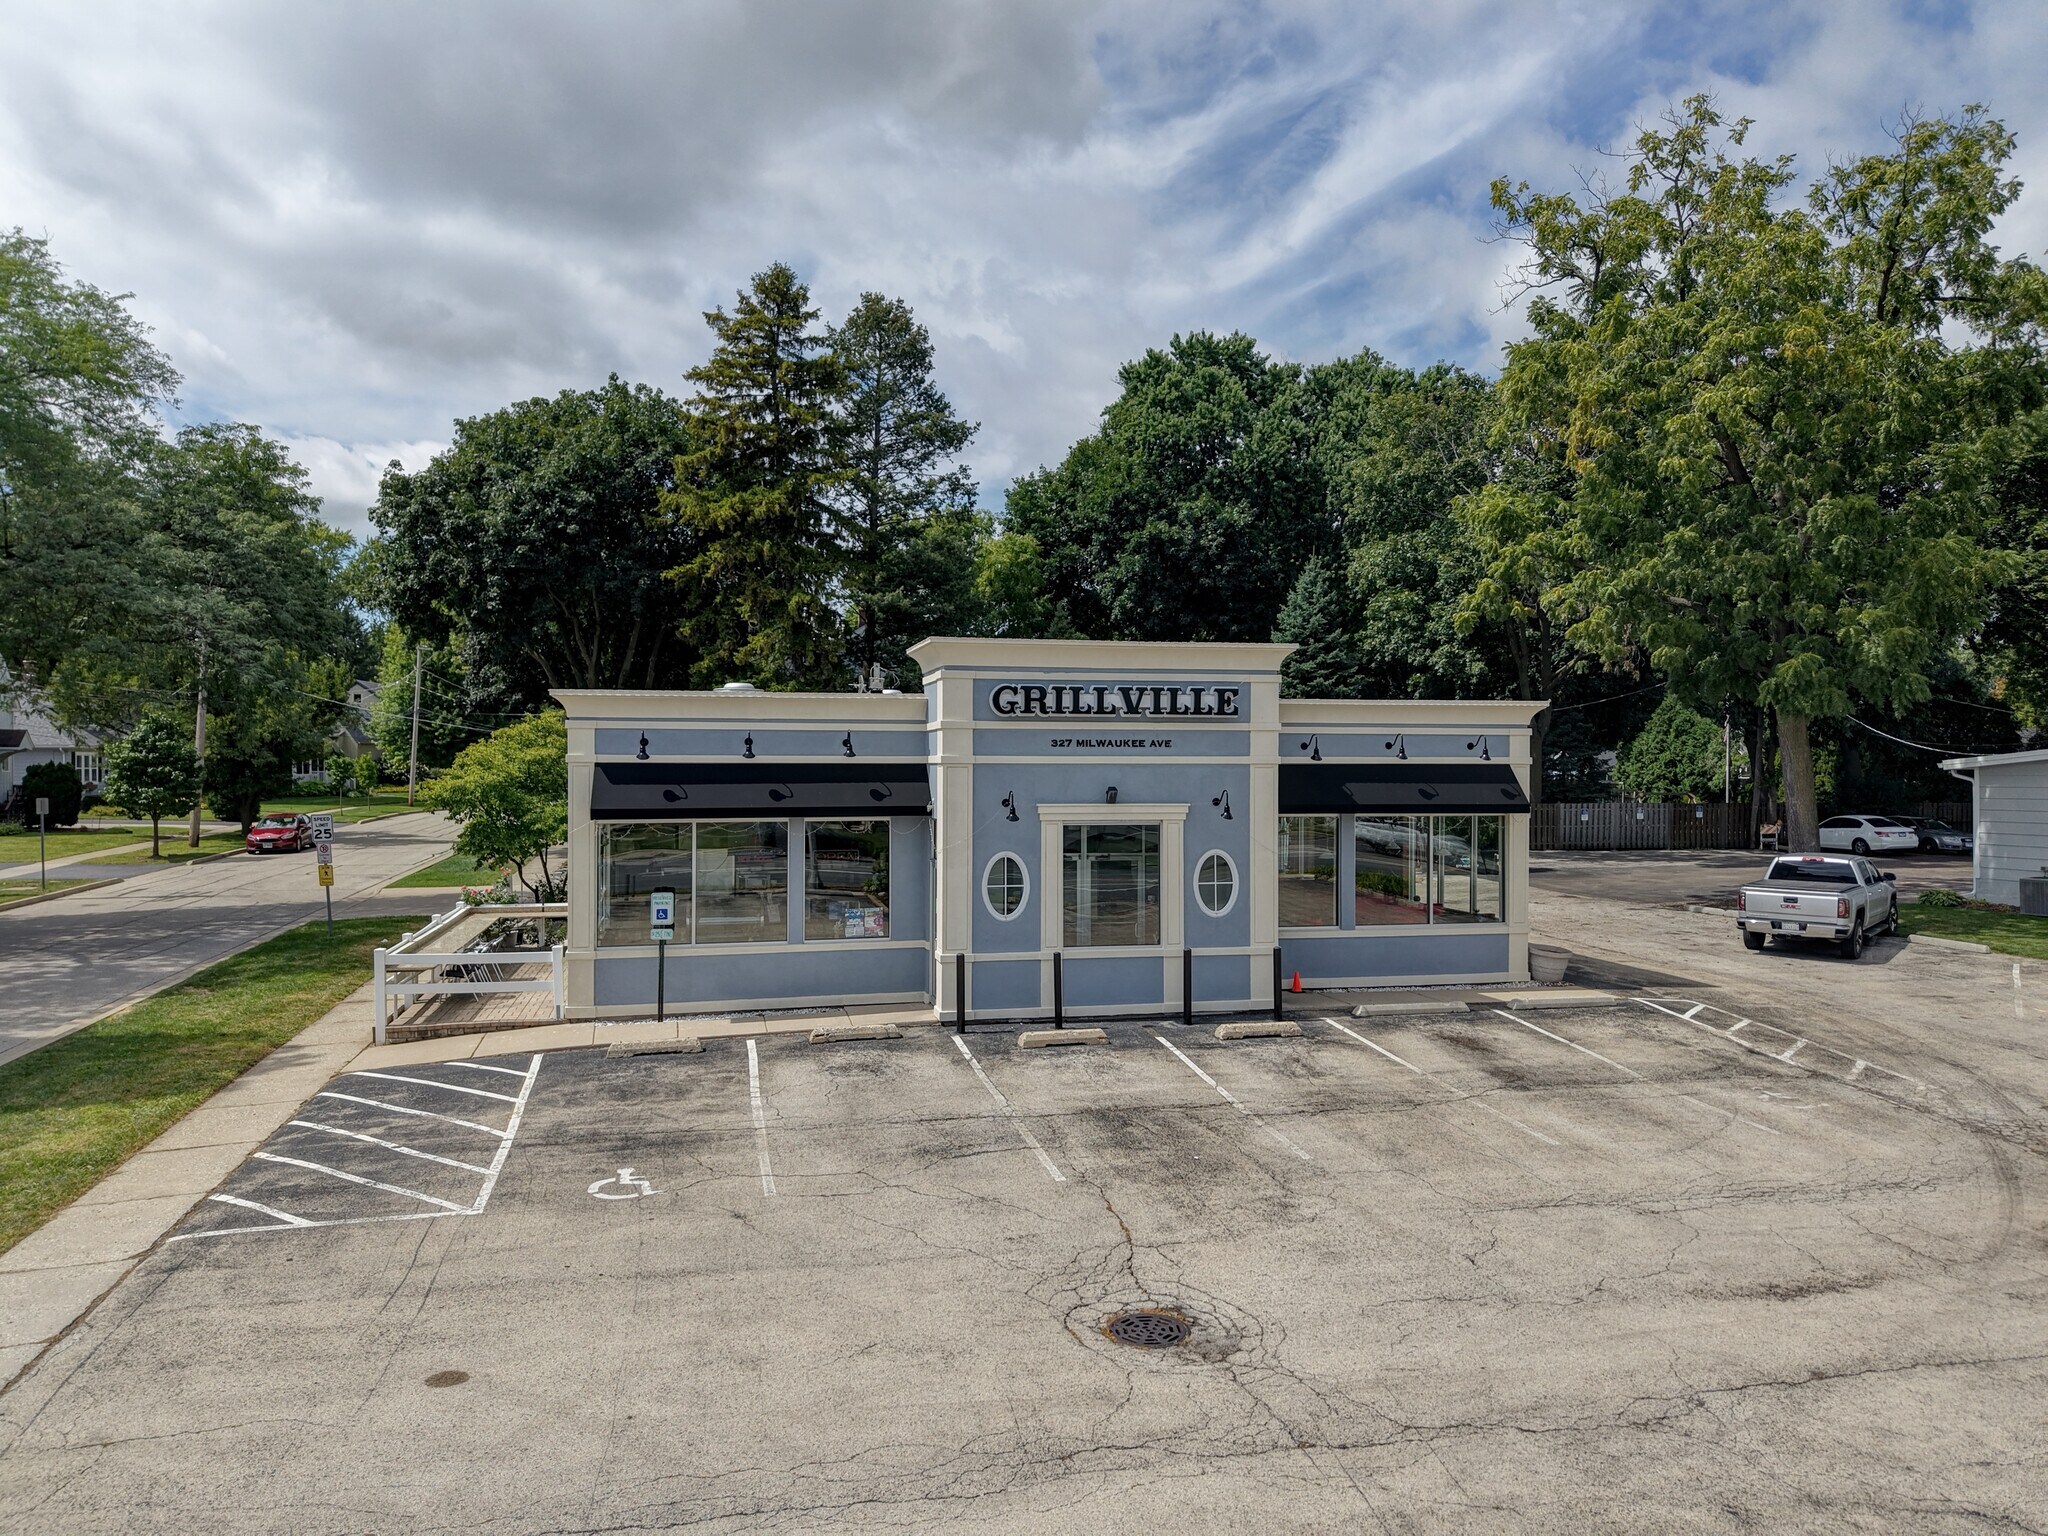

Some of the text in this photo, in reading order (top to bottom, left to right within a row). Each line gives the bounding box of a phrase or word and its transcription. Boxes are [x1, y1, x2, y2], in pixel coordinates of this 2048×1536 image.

[990, 684, 1239, 717] GRILLVILLE
[1051, 739, 1172, 748] 327 MILWAUKEE AVE
[314, 828, 332, 839] 25
